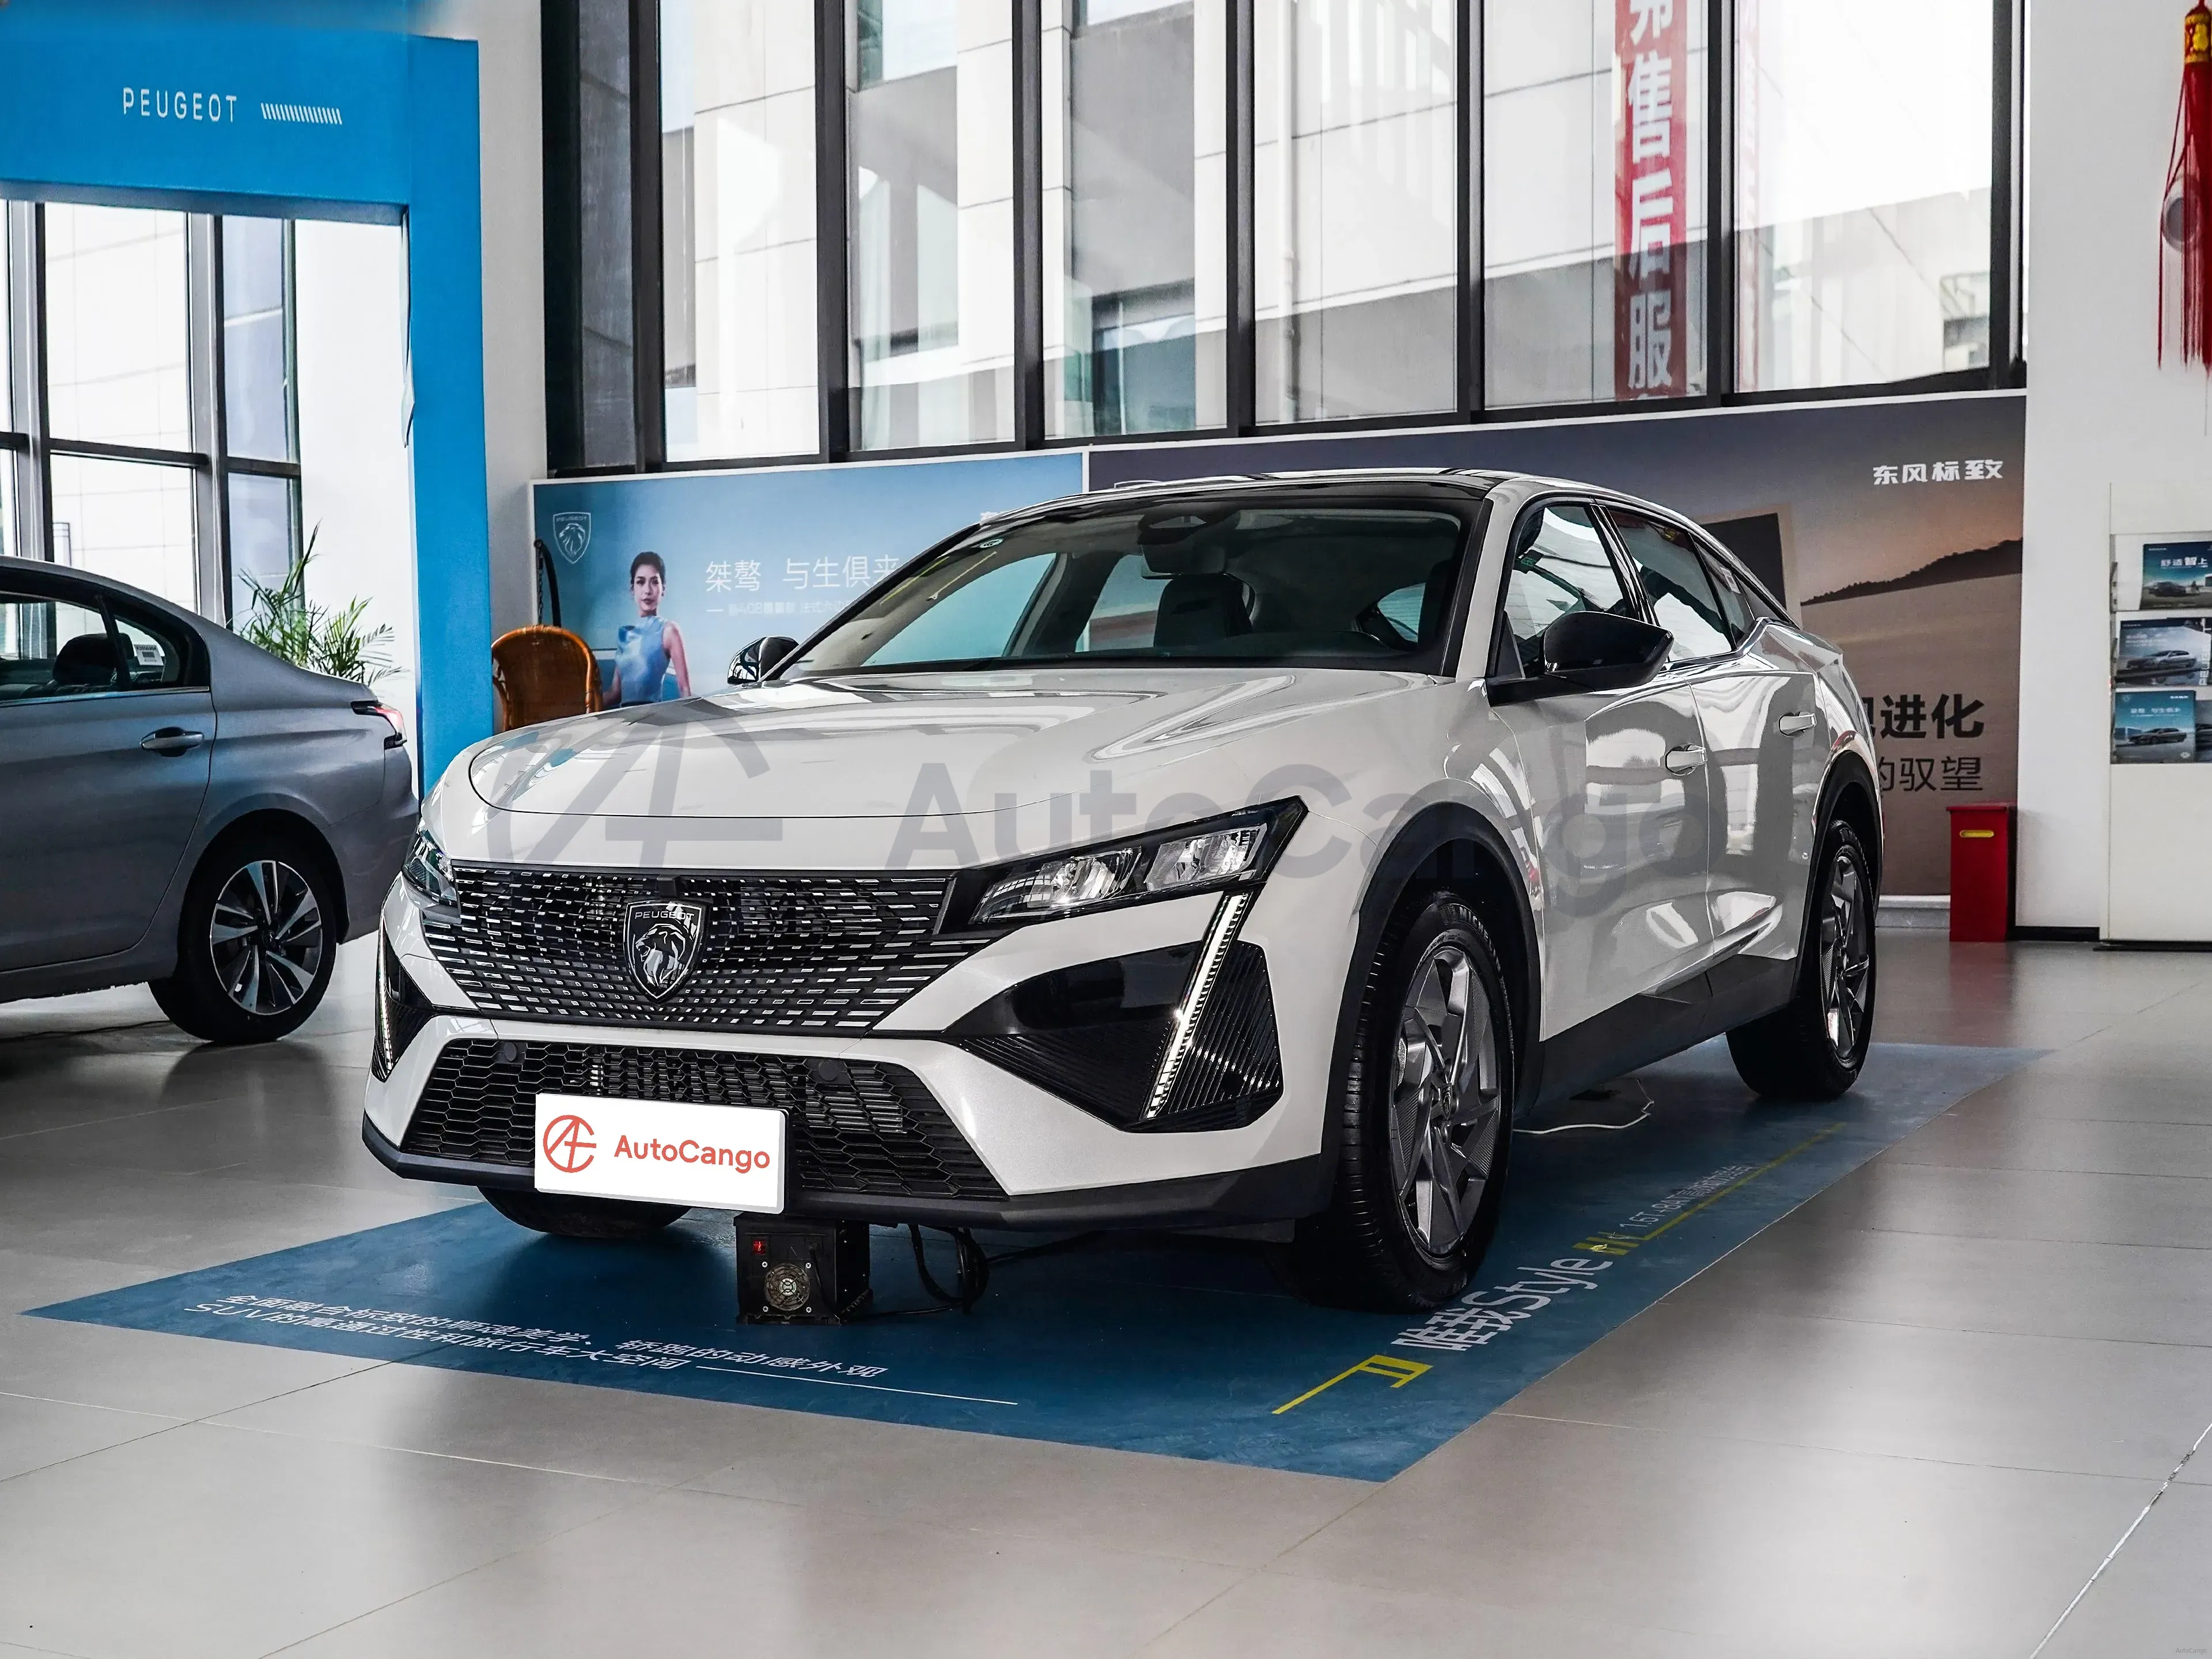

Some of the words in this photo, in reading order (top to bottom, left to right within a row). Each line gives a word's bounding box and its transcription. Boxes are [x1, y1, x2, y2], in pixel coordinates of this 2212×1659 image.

[123, 86, 237, 123] PEUGEOT
[1626, 0, 1673, 397] 售后服
[1873, 459, 2003, 485] 东风标致
[782, 554, 900, 590] 与生俱来
[1861, 693, 1984, 739] 进化
[634, 911, 695, 920] PEUGEOT
[1390, 1258, 1613, 1351] 唯我Style
[615, 1339, 889, 1377] 轿跑的动感外观
